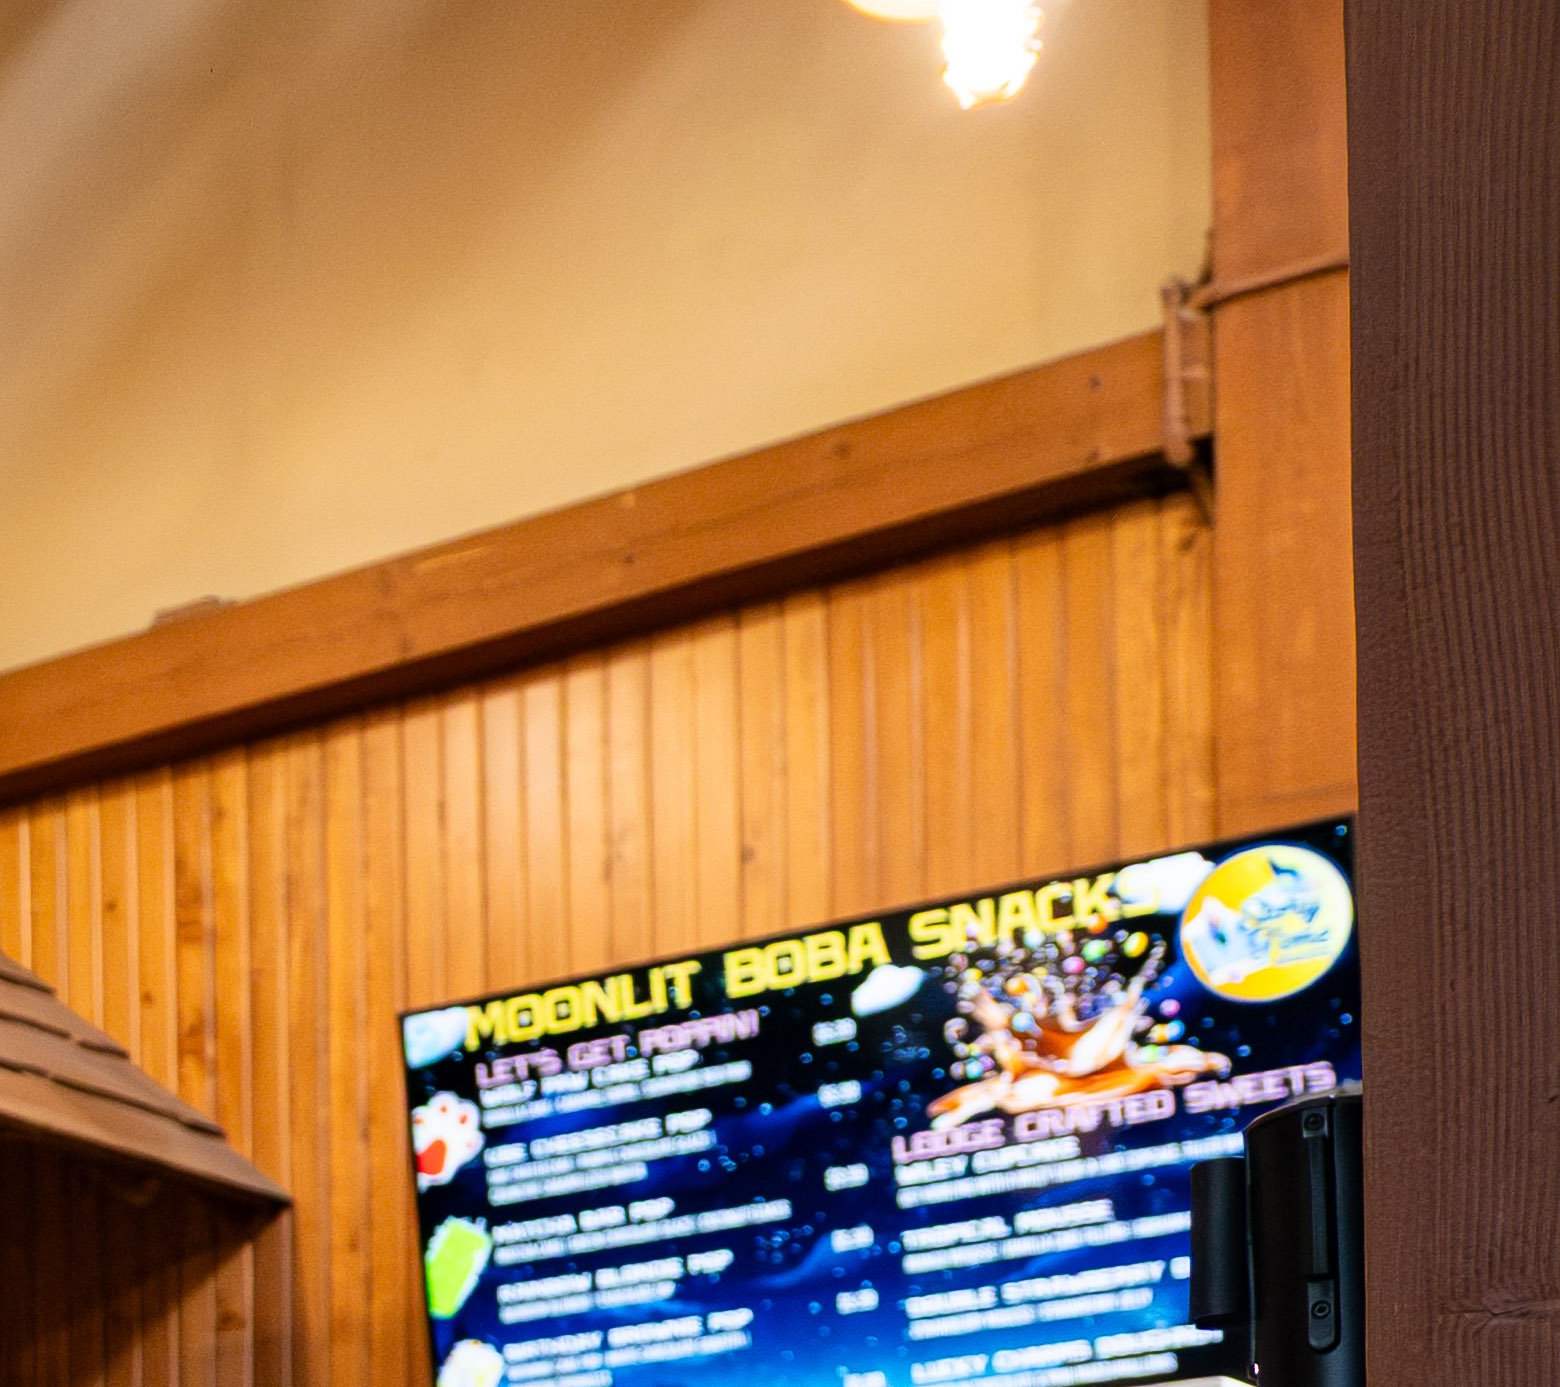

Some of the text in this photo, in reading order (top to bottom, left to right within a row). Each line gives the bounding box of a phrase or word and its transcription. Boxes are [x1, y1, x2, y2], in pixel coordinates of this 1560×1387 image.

[465, 961, 702, 1052] MOONLIT
[724, 930, 893, 1002] BOBA
[909, 870, 1160, 962] SNACKS
[476, 1047, 563, 1089] LET'S
[567, 1033, 632, 1071] GET
[892, 1061, 1337, 1163] LODGE CRAFTED SWEETS
